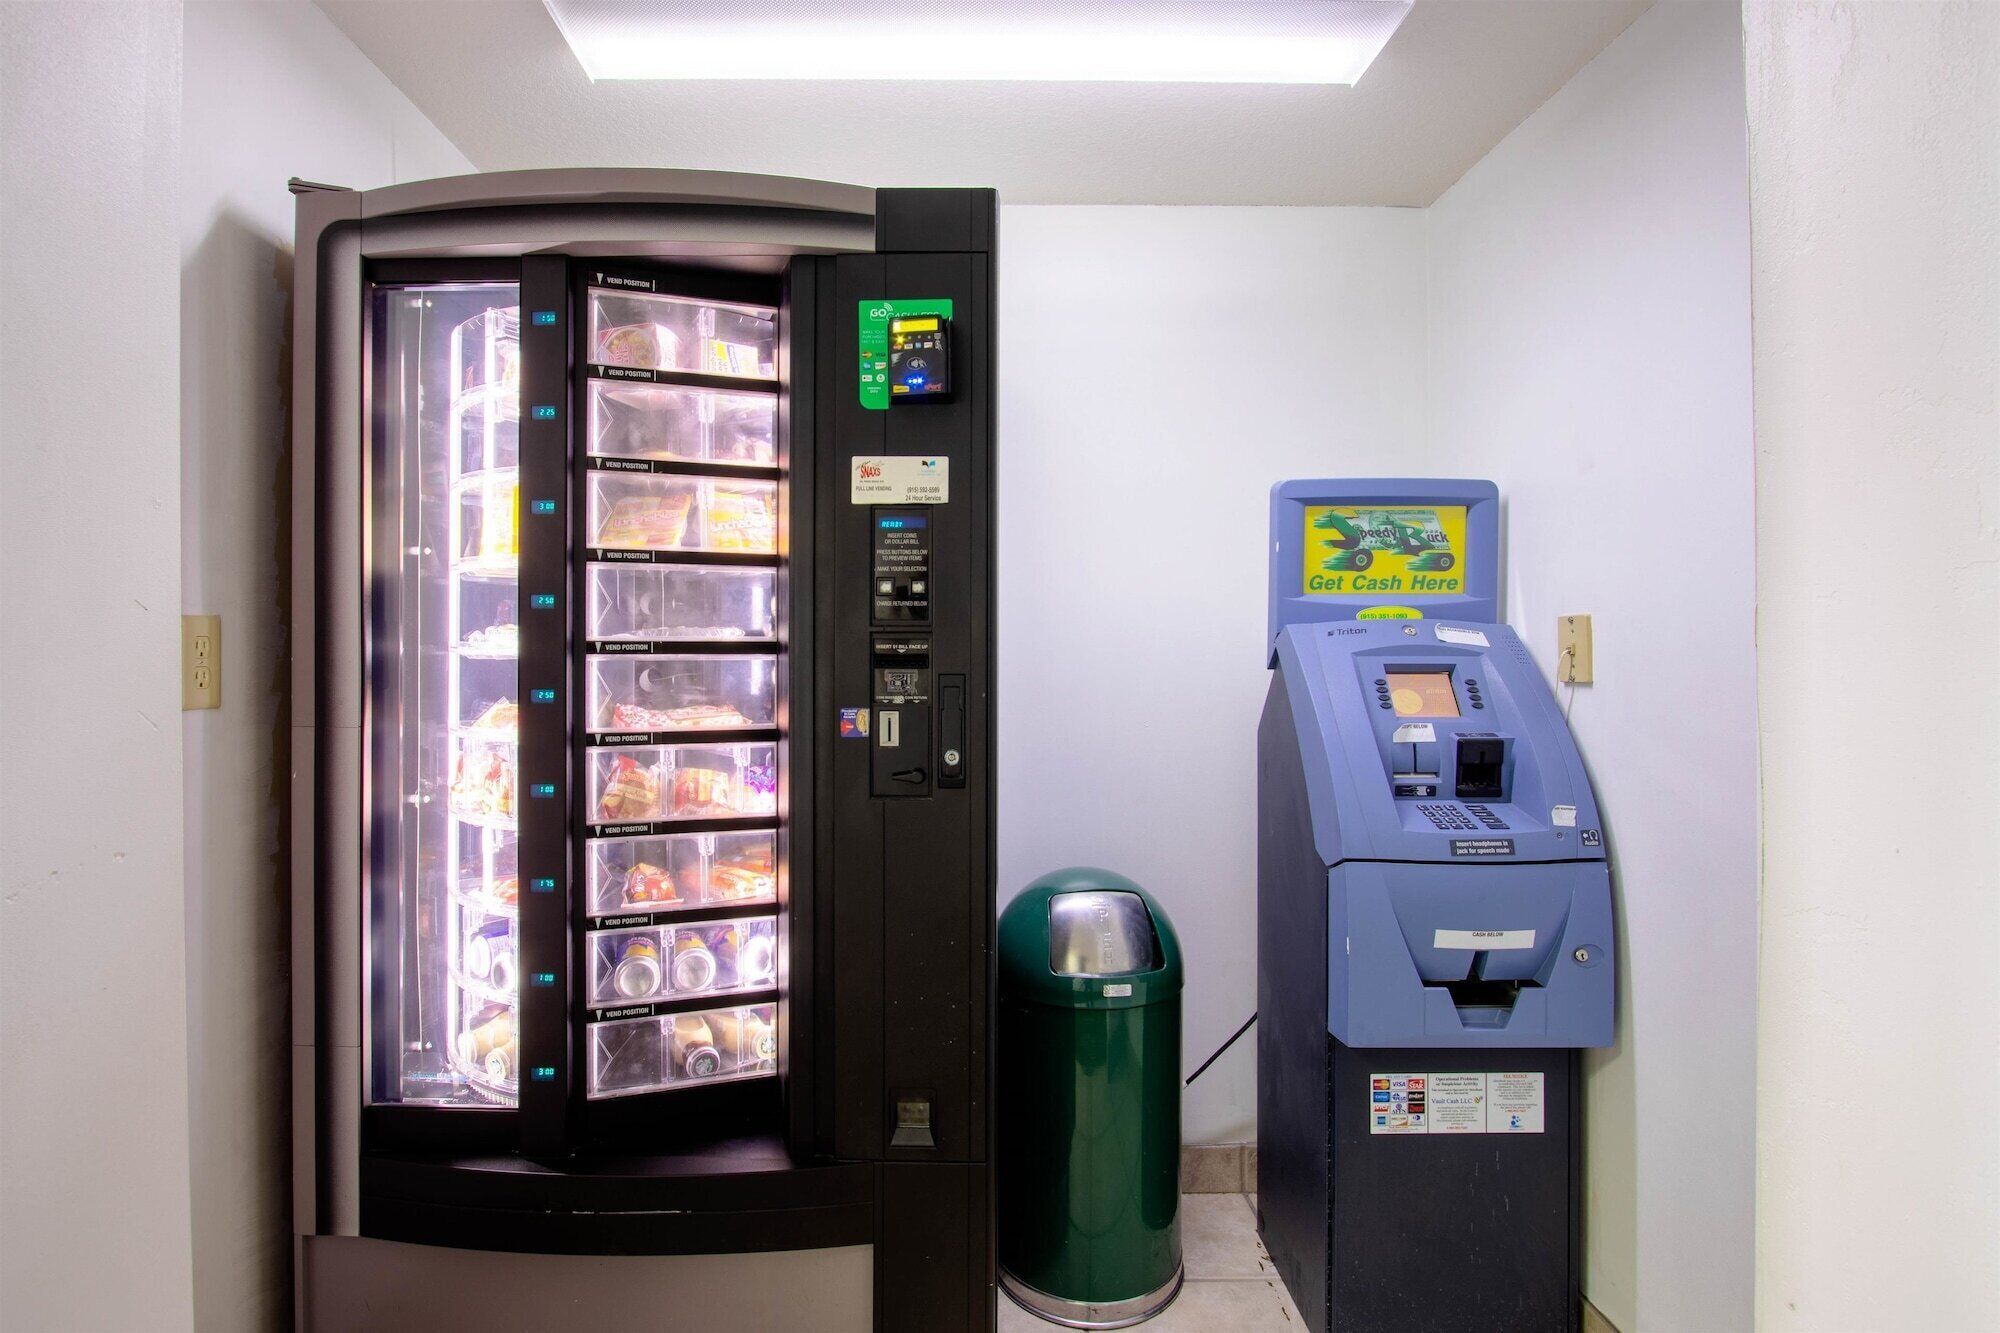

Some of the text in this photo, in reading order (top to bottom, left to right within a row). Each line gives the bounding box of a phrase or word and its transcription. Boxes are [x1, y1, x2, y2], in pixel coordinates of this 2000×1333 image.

[624, 280, 650, 288] POSITION
[870, 308, 887, 317] GO
[1309, 574, 1459, 590] Get Cash Here
[623, 1007, 649, 1015] POSITION
